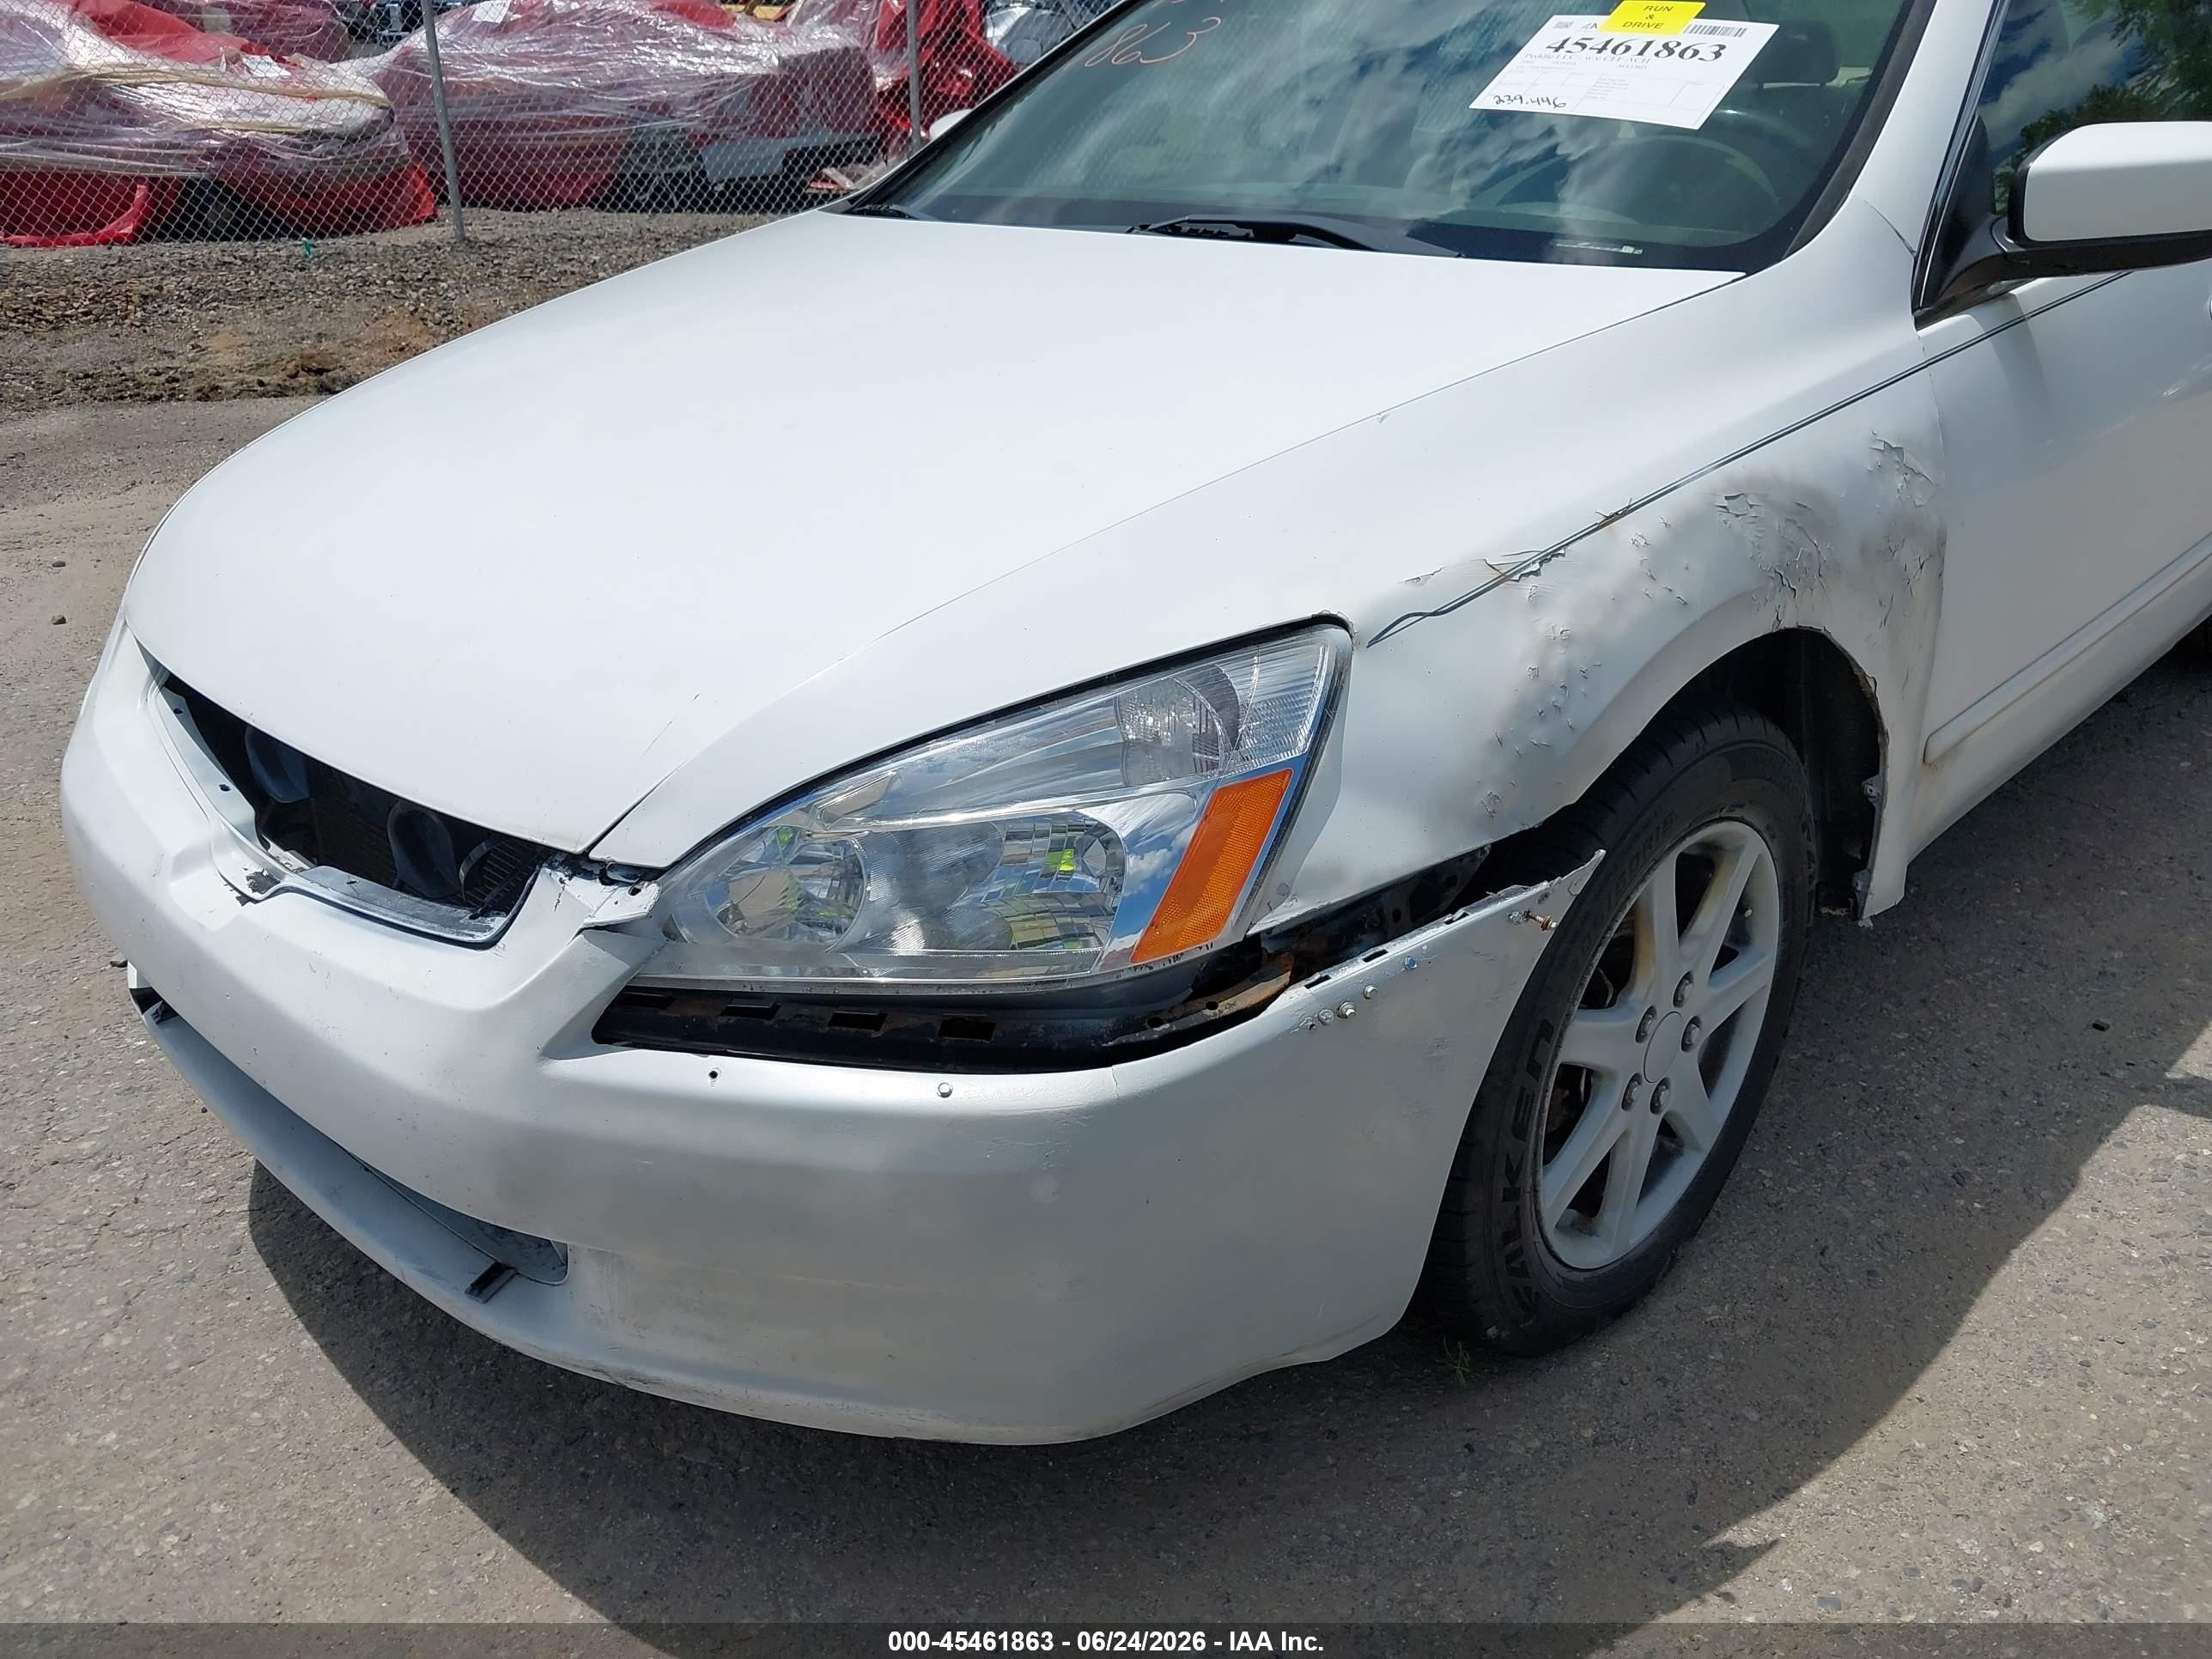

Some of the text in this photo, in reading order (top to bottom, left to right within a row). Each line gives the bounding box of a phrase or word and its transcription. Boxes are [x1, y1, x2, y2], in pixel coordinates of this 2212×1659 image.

[1622, 21, 1665, 29] DRIVE
[1085, 16, 1222, 67] 863
[1547, 37, 1728, 61] 45461863
